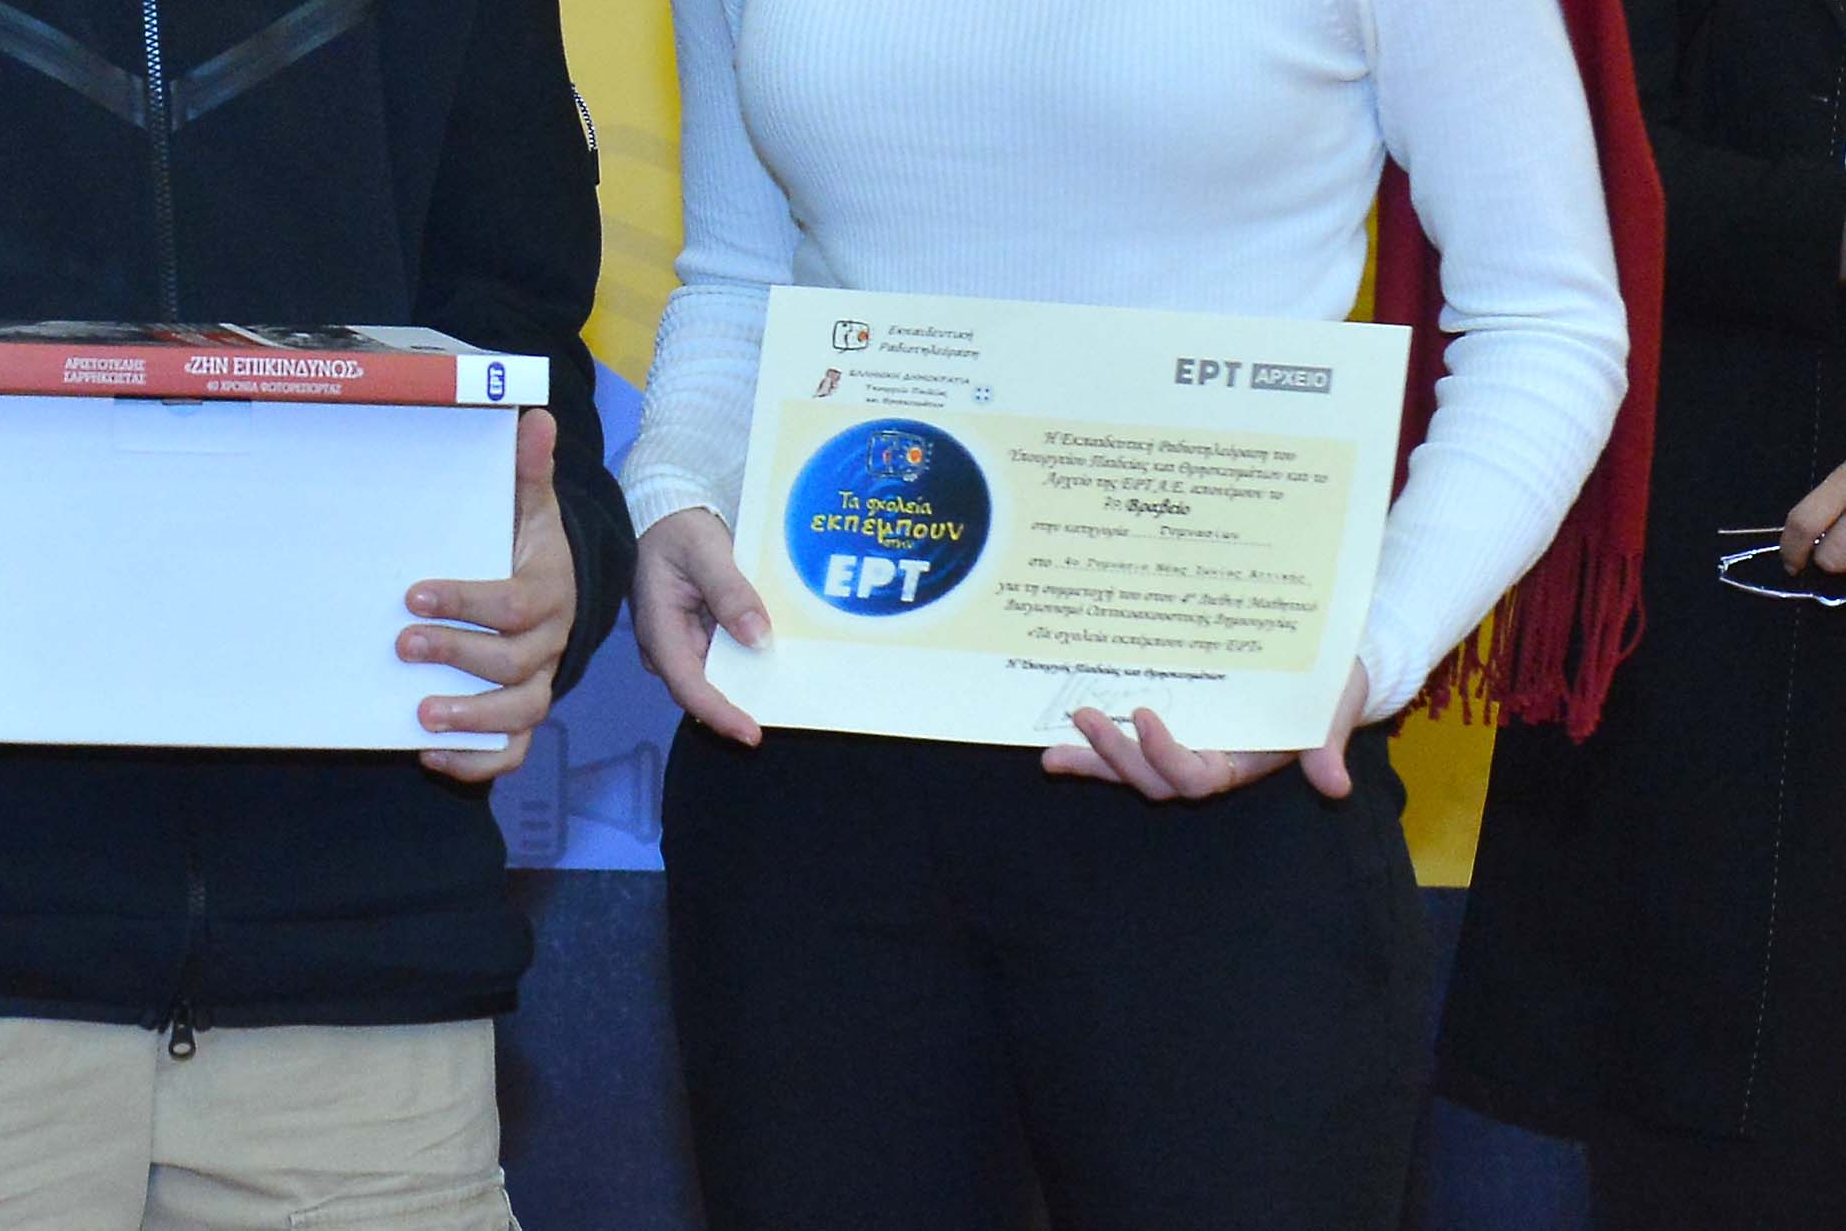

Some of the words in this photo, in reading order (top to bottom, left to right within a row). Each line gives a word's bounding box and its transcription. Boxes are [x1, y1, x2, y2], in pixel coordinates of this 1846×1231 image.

[64, 357, 146, 371] ΑΡΙΣΤΟΤΕΛΗΣ
[1175, 358, 1242, 387] ΕΡΤ
[1255, 369, 1327, 388] ΑΡΧΕΙΟ
[220, 382, 259, 393] ΧΡΟΝΙΑ
[489, 366, 503, 396] ΕΡΤ
[838, 490, 860, 509] Τα
[866, 496, 932, 515] σχολεία
[823, 553, 931, 602] ΕΡΤ
